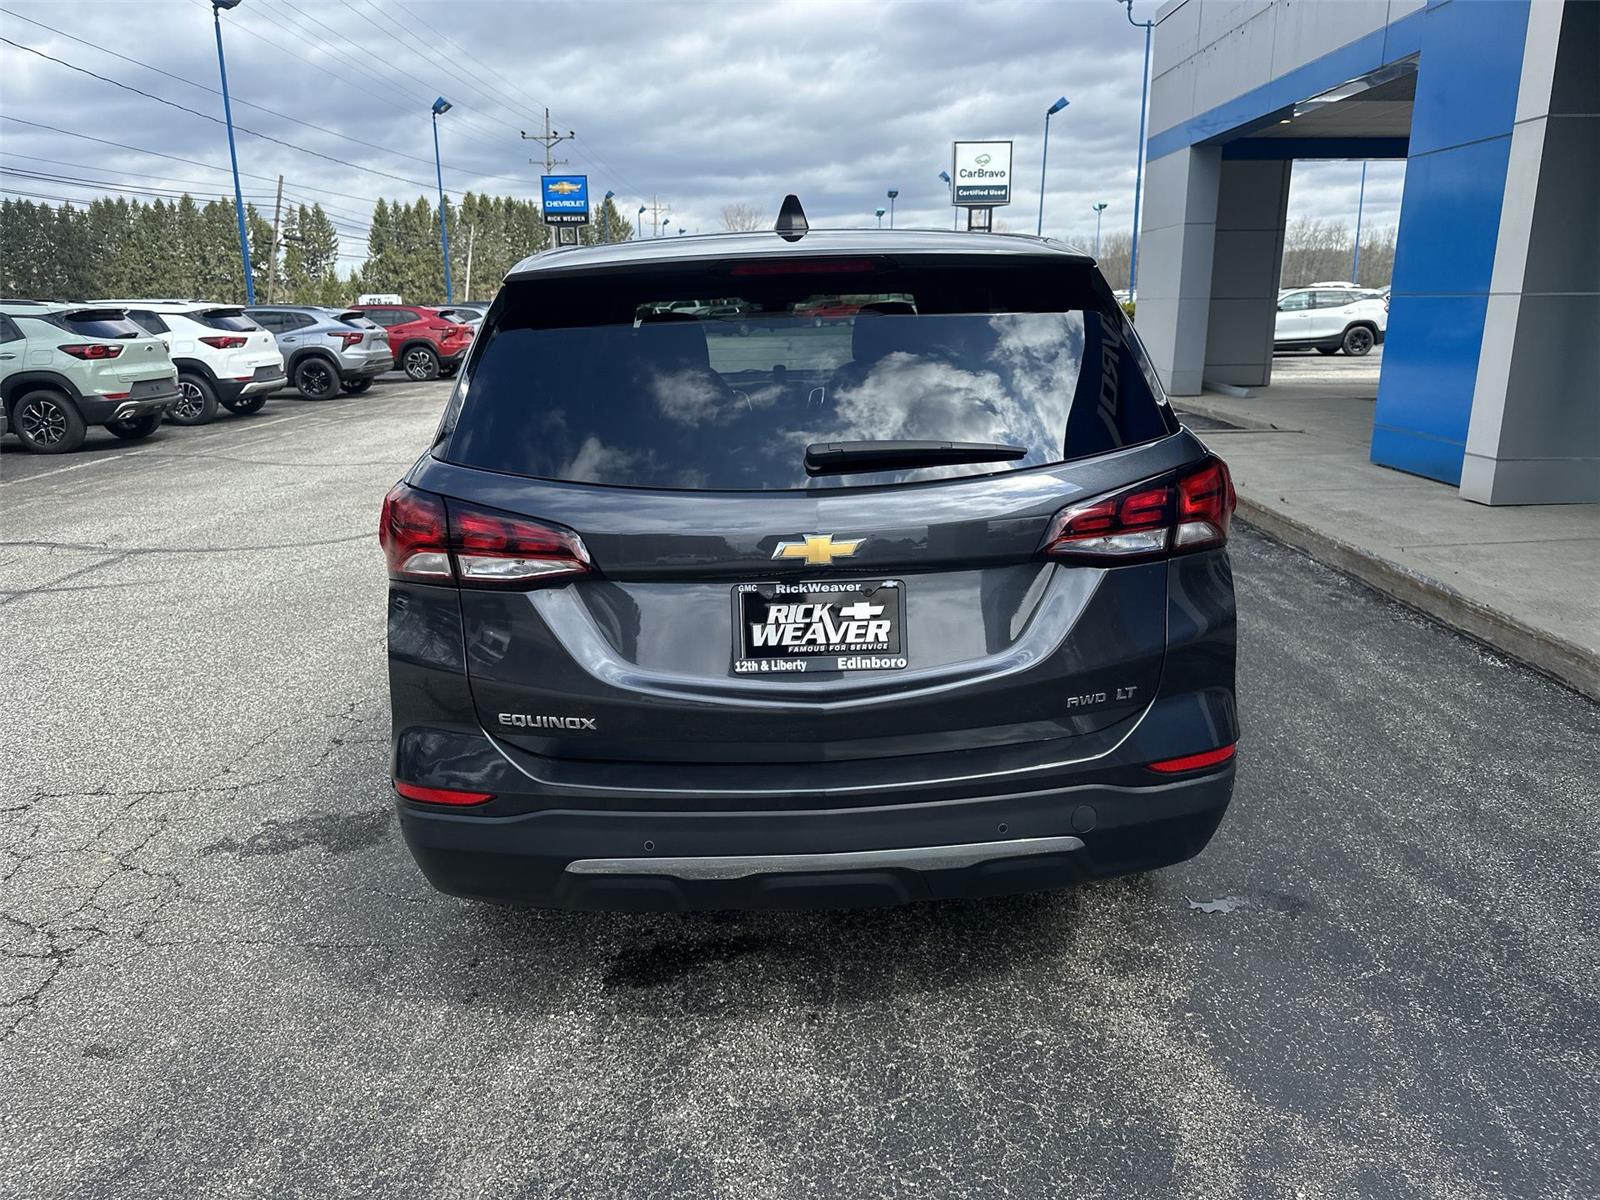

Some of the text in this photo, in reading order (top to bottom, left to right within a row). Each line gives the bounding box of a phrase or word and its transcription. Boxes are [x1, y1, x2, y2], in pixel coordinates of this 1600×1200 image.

[959, 168, 1006, 178] CarBravo
[775, 583, 861, 594] RickWeaver
[766, 603, 834, 625] RICK
[752, 620, 891, 647] WEAVER
[788, 645, 825, 653] FAMOUS
[850, 643, 889, 651] SERVICE
[735, 659, 807, 672] 12th & Liberty
[837, 657, 907, 670] Edinboro
[1066, 686, 1137, 708] AWD LT
[498, 713, 597, 730] EQUINOX
